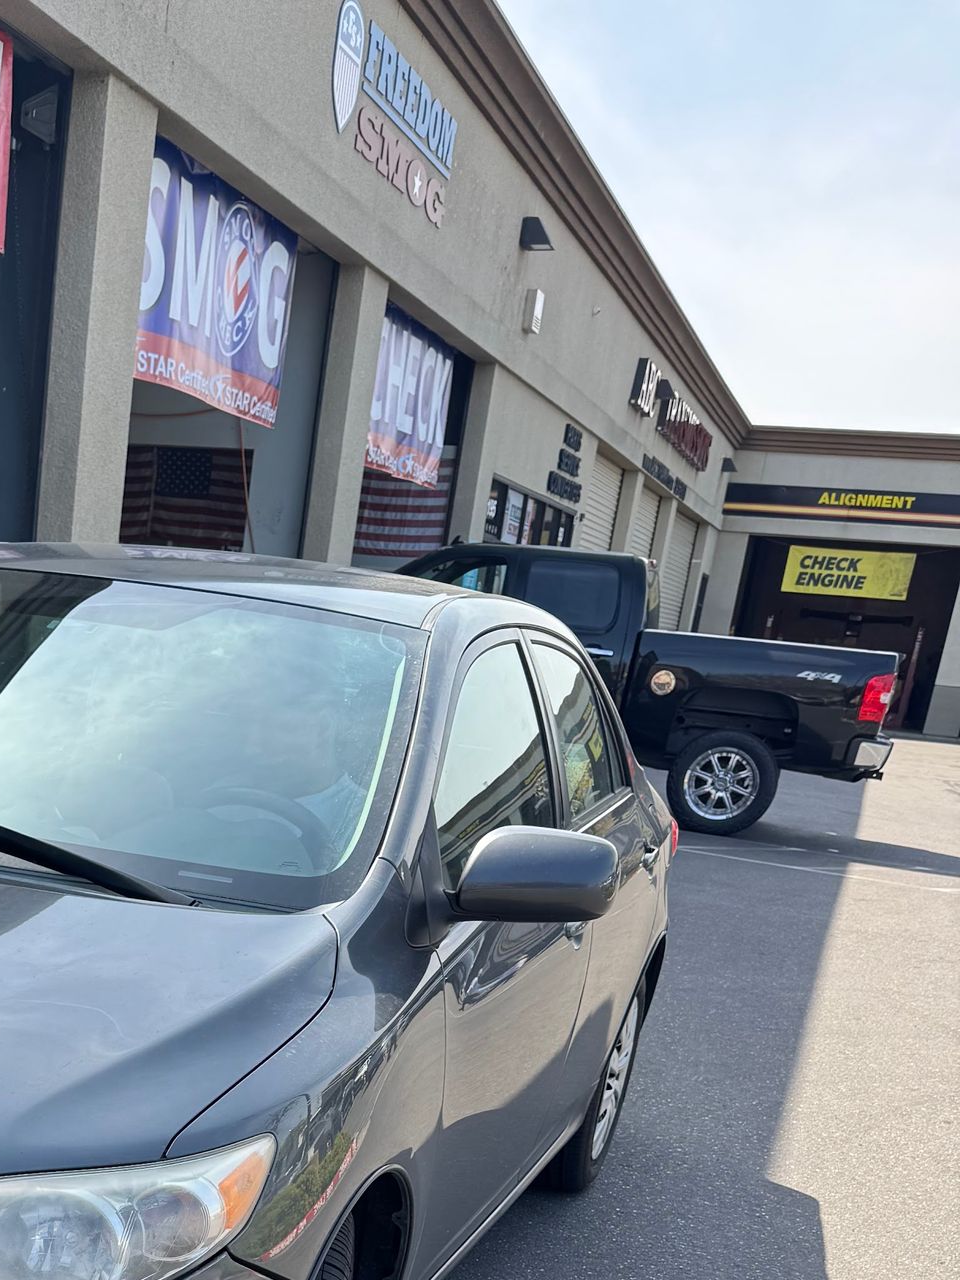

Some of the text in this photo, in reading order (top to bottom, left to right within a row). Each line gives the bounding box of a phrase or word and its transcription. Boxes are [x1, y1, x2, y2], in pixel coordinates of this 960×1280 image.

[363, 19, 458, 170] FREEDOM
[354, 106, 446, 230] SMOG
[137, 350, 176, 380] STAR
[225, 386, 250, 411] STAR
[818, 492, 916, 509] ALIGNMENT
[795, 571, 867, 590] ENGINE
[798, 554, 863, 573] CHECK
